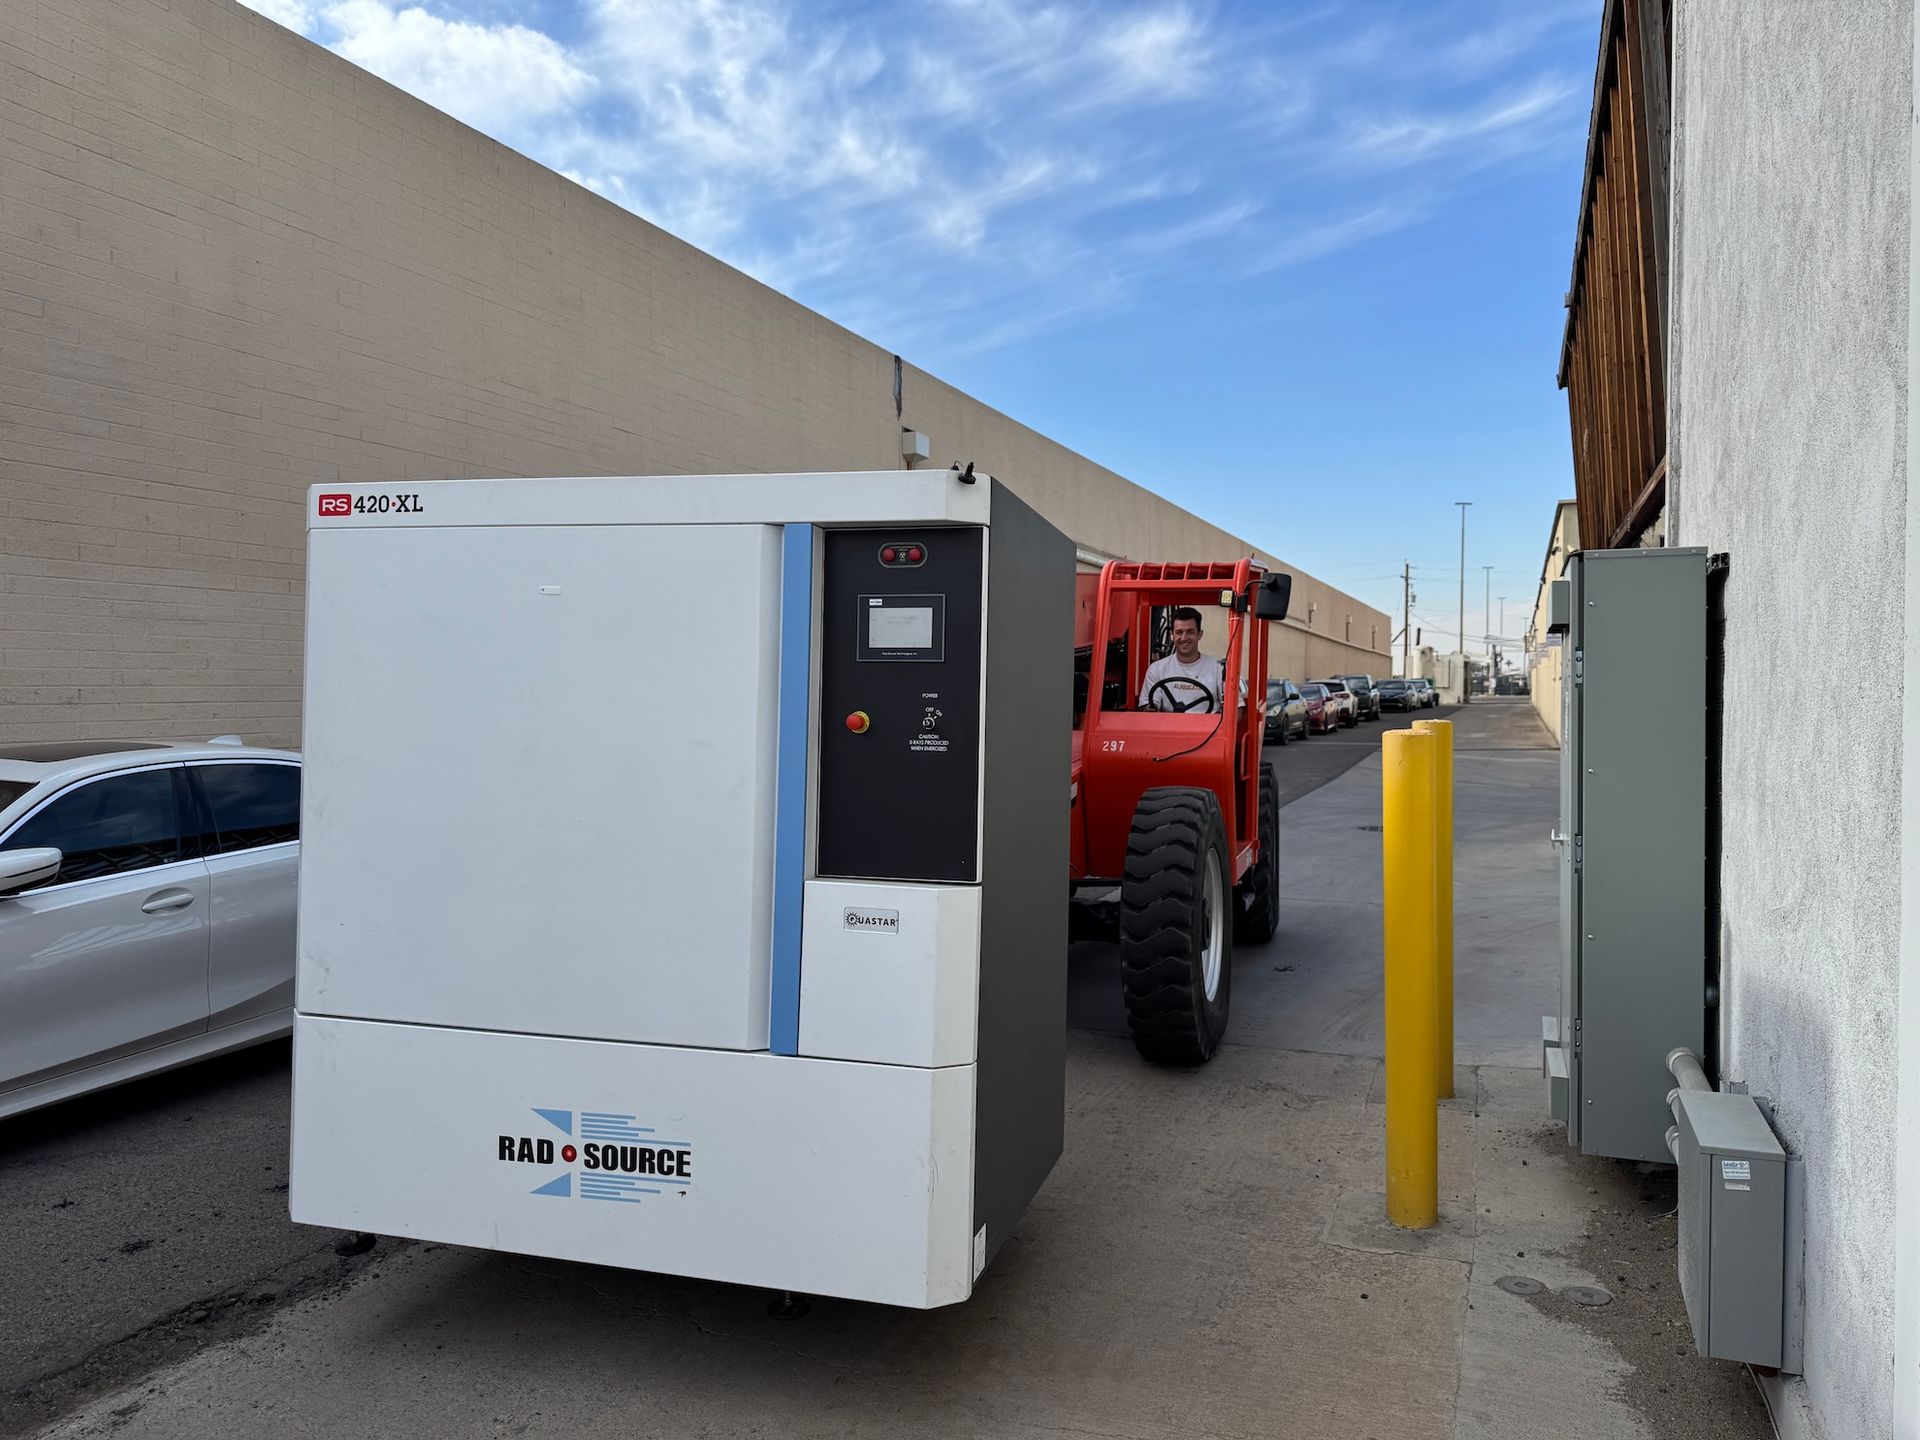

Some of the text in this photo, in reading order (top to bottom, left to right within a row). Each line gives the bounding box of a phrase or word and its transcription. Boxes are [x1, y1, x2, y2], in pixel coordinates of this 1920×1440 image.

[321, 498, 349, 512] RS
[1102, 740, 1125, 752] 297
[498, 1135, 692, 1178] RAD SOURCE
